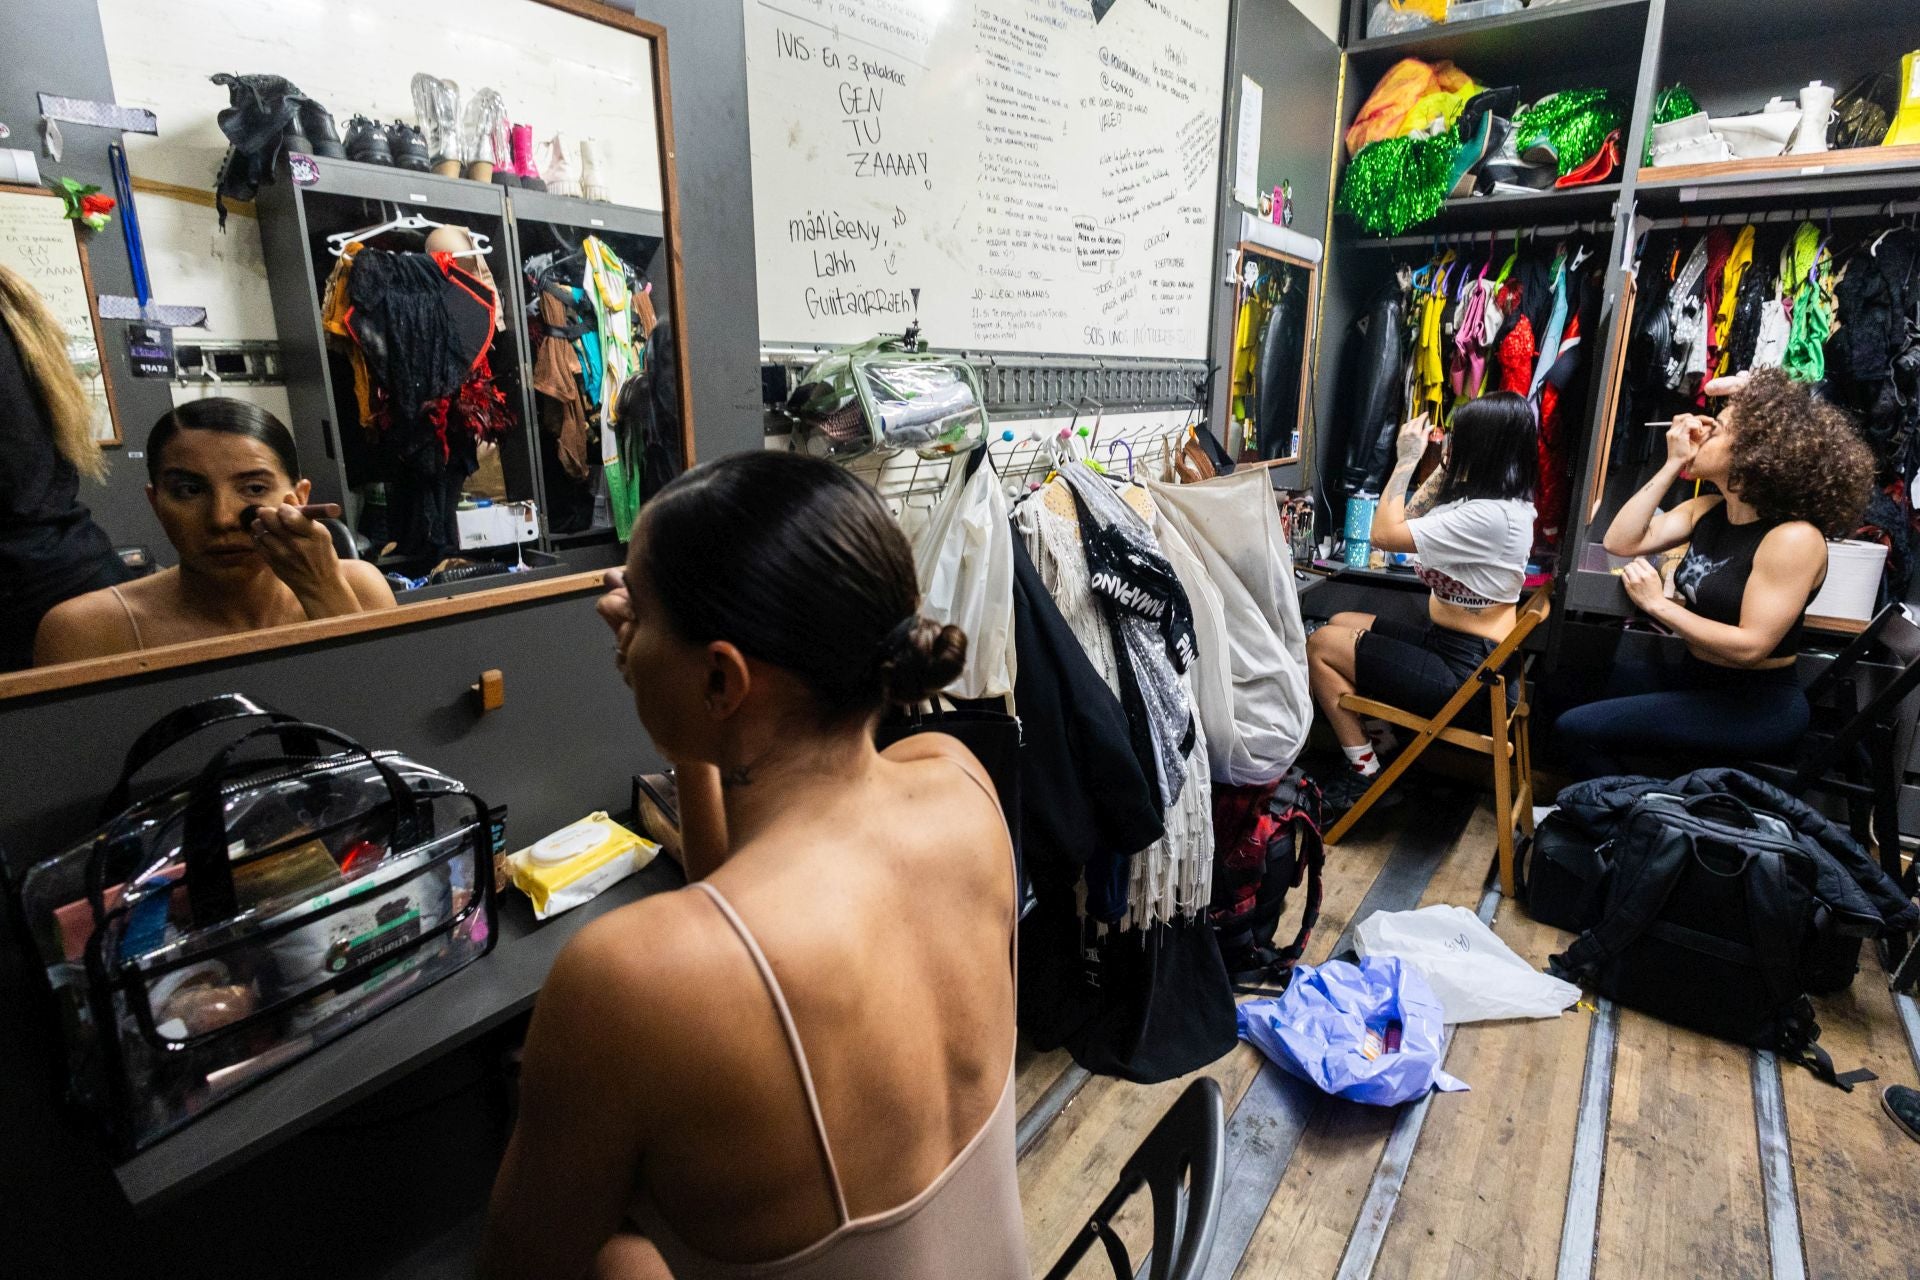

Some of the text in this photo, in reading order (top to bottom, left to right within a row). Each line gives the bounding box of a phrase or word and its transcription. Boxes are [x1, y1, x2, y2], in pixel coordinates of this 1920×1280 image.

[847, 55, 859, 71] 3
[839, 82, 883, 115] GEN
[842, 116, 881, 146] TU
